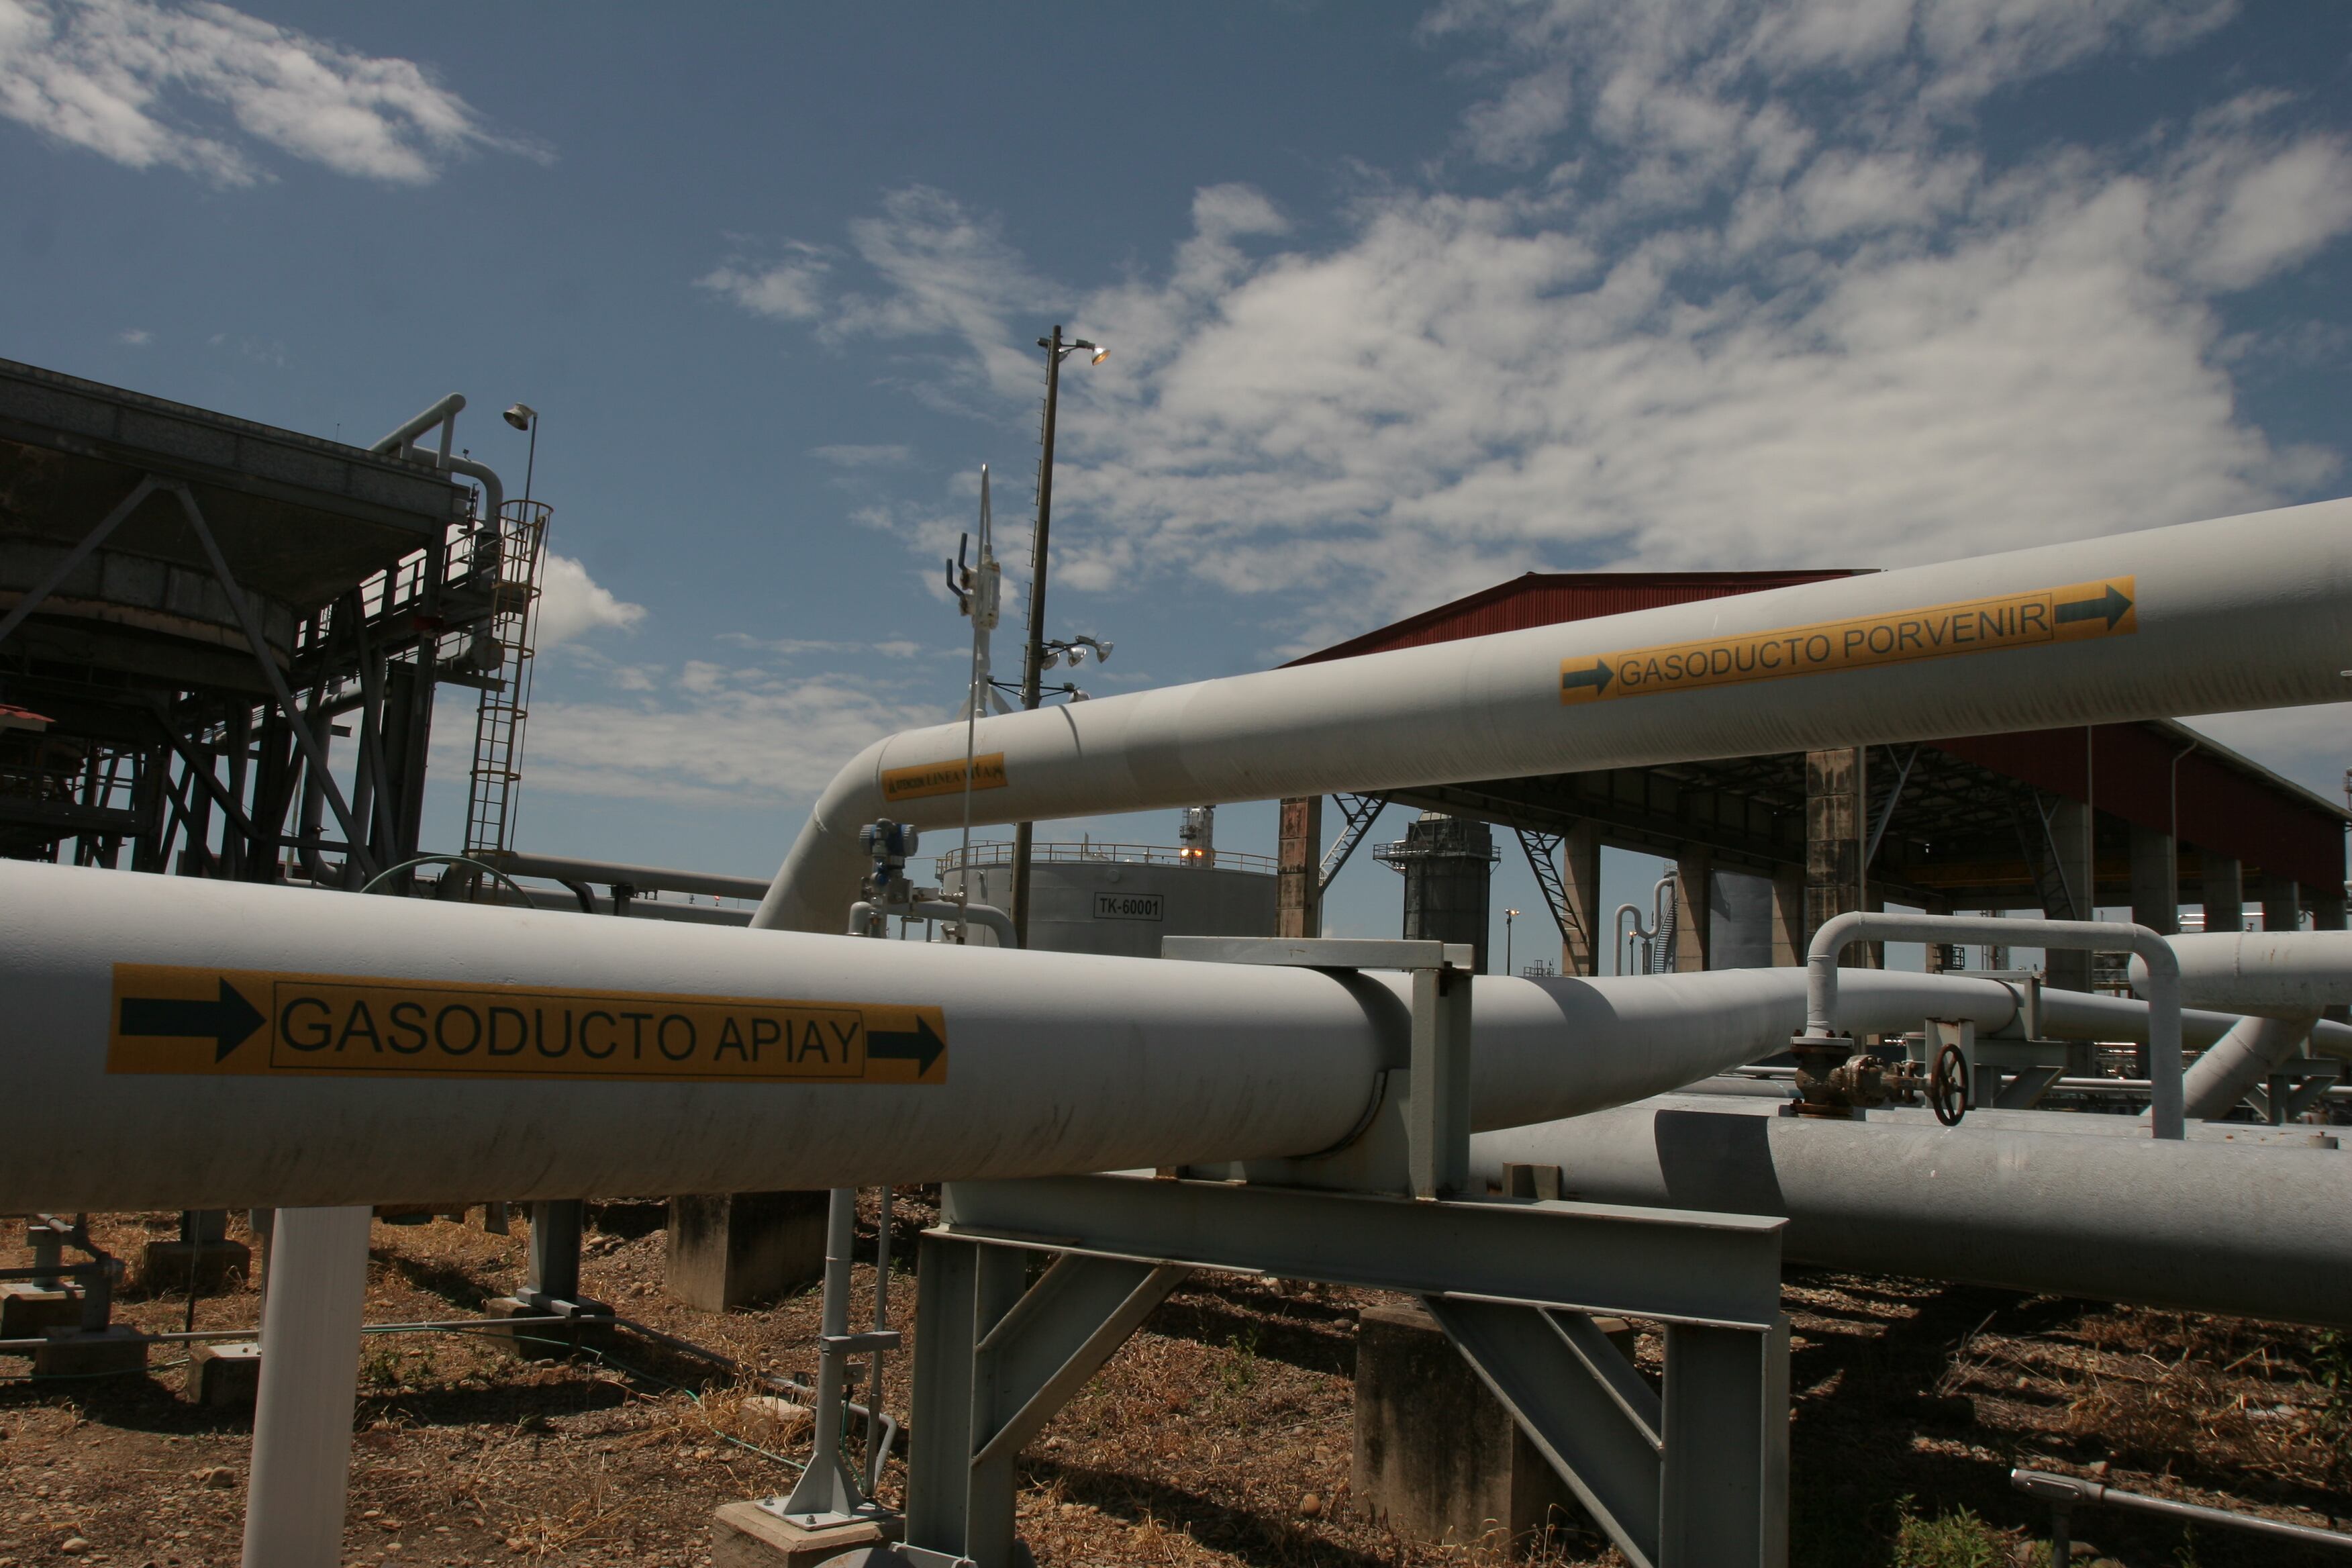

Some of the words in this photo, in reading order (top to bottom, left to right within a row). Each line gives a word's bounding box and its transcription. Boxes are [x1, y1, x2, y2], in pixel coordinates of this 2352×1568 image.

[1619, 634, 1831, 687] GASODUCTO
[1843, 603, 2049, 658] PORVENIR
[926, 769, 961, 786] LINEA
[1099, 897, 1159, 916] TK-60001
[280, 997, 697, 1061] GASODUCTO
[713, 1016, 860, 1064] APIAY
